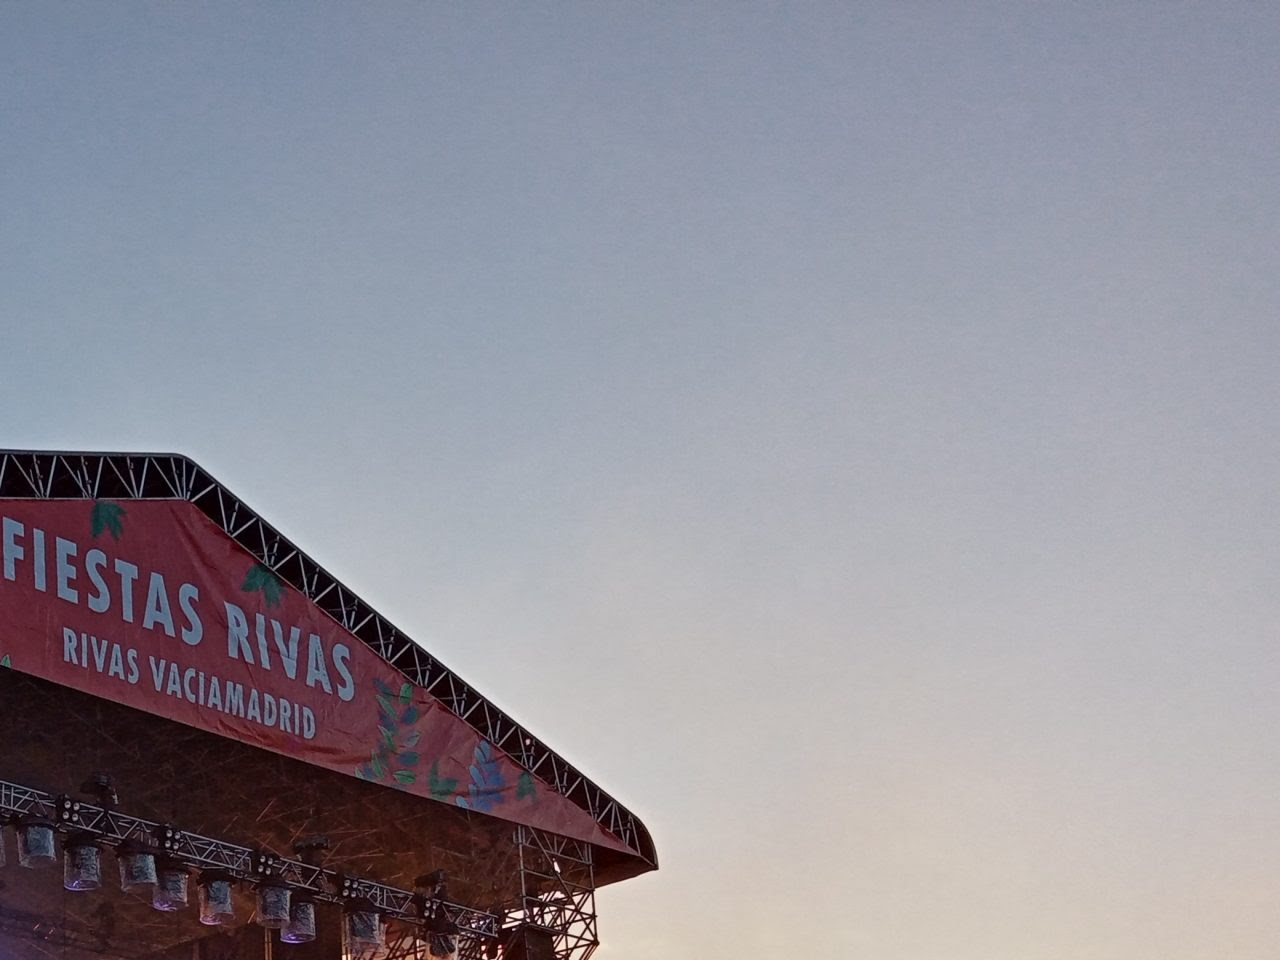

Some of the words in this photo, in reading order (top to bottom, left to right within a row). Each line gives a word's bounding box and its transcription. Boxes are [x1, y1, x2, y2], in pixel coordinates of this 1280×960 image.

[1, 516, 204, 646] FIESTAS
[224, 600, 356, 702] RIVAS
[62, 625, 140, 685] RIVAS
[148, 656, 317, 740] VACIAMADRID
